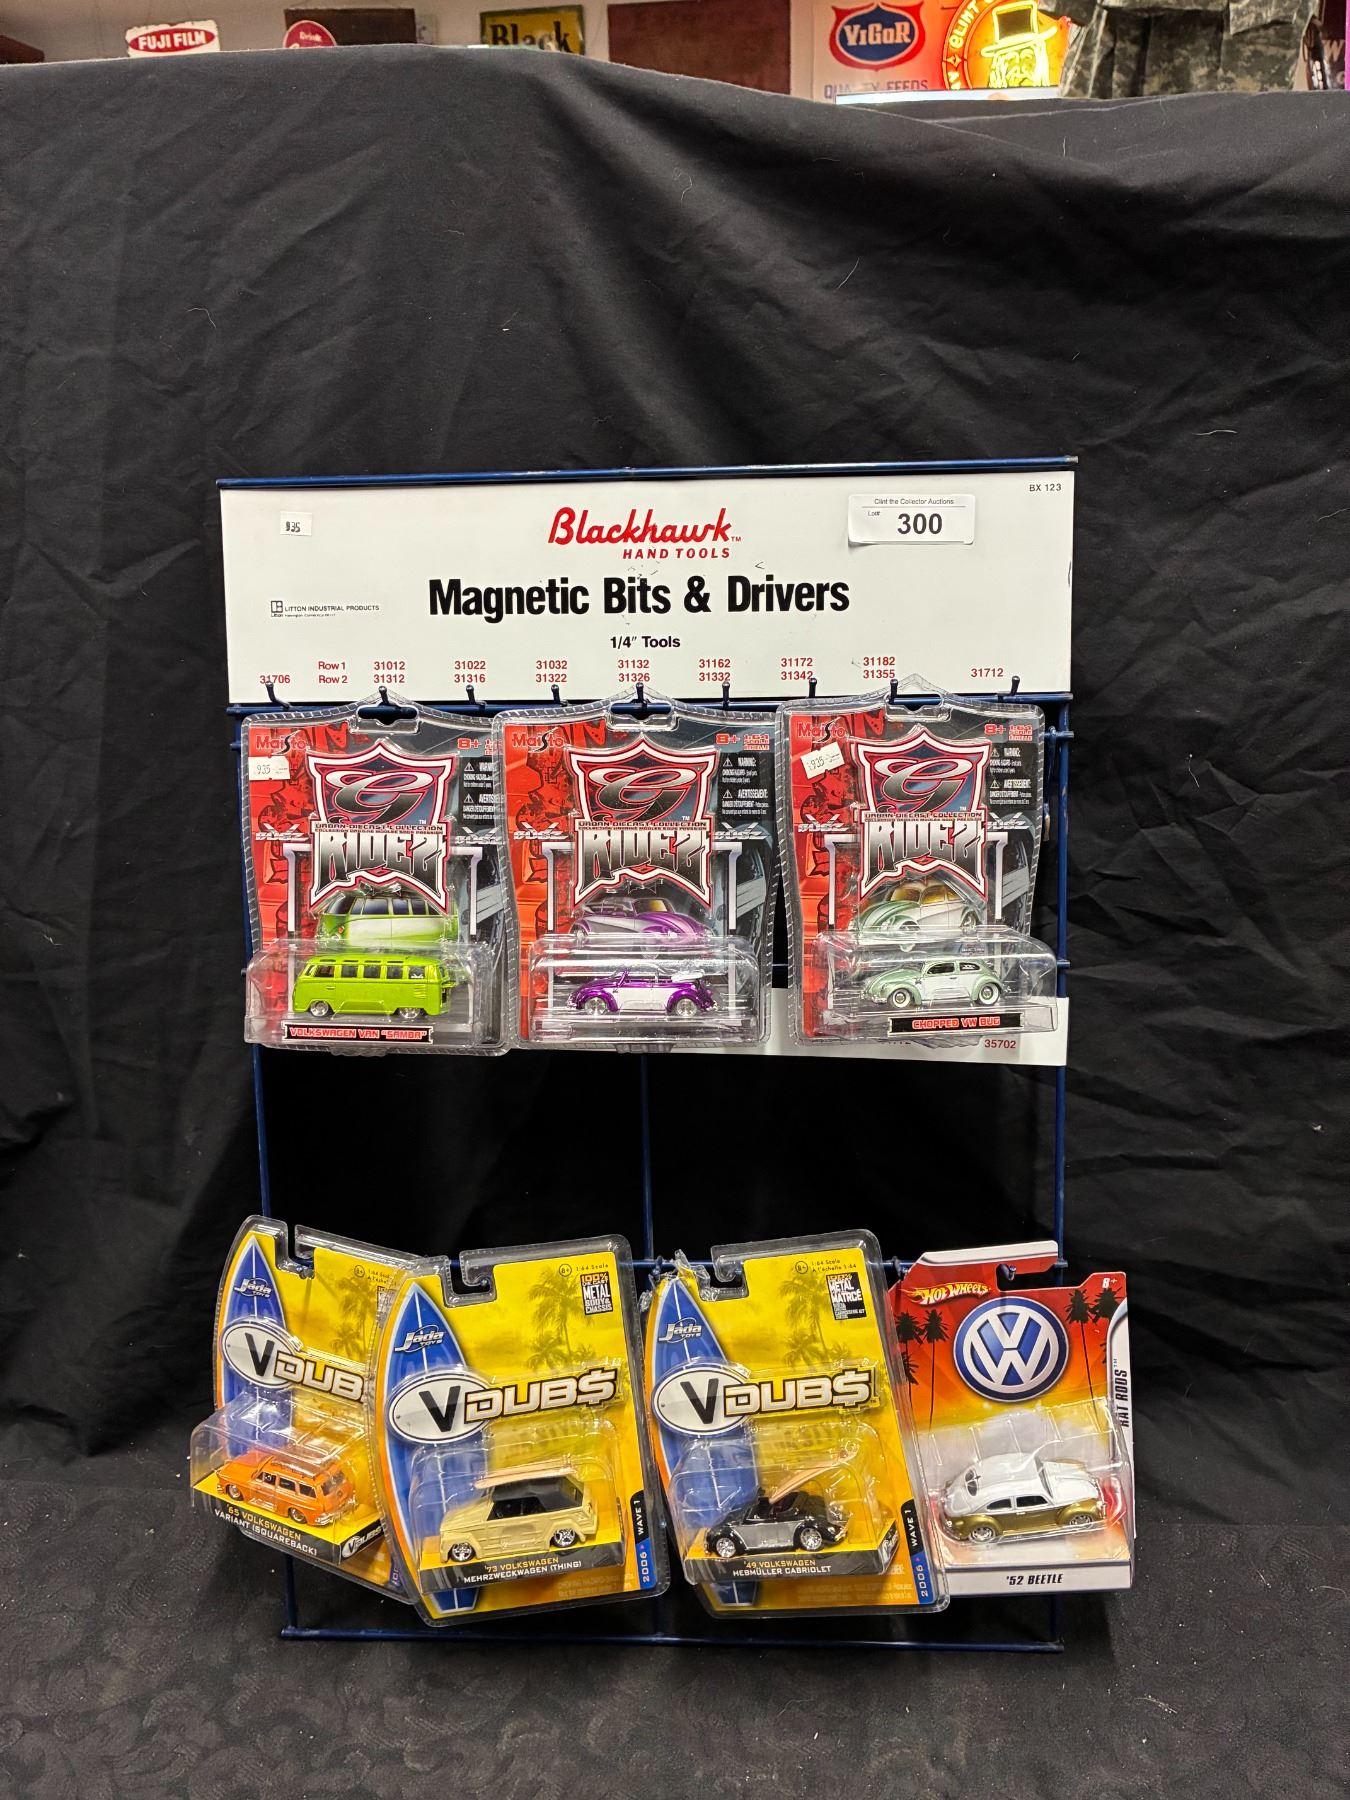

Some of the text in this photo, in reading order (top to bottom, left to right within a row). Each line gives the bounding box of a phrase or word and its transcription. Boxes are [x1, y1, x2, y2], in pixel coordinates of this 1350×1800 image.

[138, 31, 206, 50] FUJI FILM
[1029, 483, 1062, 492] BX 123
[548, 507, 732, 545] Blackhawk
[897, 512, 943, 535] 300
[623, 547, 730, 560] HAND TOOLS
[429, 574, 850, 624] Magnetic Bits & Drivers
[641, 635, 681, 648] Tools
[318, 656, 896, 671] Row 1 31012 31022 31032 31132 31162 31172 31182
[259, 674, 291, 684] 31706
[318, 669, 896, 684] Row 2 31312 31316 31322 31326 31332 31342 31355
[970, 667, 1004, 678] 31712
[797, 719, 847, 741] Maisto
[984, 723, 1006, 734] 8+
[255, 731, 309, 753] Maisto
[457, 738, 481, 749] 8+
[512, 728, 565, 751] Maisto
[716, 733, 740, 745] 8+
[912, 1016, 1000, 1029] CHOPPED VW BUG
[290, 1027, 356, 1038] VOLKSWAGEN
[358, 1028, 379, 1039] VAN
[984, 1039, 1017, 1050] 35702
[234, 1278, 272, 1294] Jada
[581, 1273, 609, 1283] 100%
[1102, 1277, 1118, 1288] 8+
[583, 1284, 611, 1300] METAL
[923, 1286, 950, 1305] HOT
[585, 1298, 605, 1307] BODY
[585, 1304, 613, 1314] CHASSIS
[395, 1331, 445, 1351] Jada
[658, 1323, 702, 1343] Jada
[244, 1332, 366, 1403] V DUB
[1114, 1369, 1129, 1402] RODS
[418, 1385, 461, 1433] V
[680, 1378, 719, 1425] V
[227, 1504, 302, 1541] '65 VOLKSWAGEN
[635, 1507, 644, 1535] WAVE
[214, 1509, 317, 1556] VARIANT (SQUAREBACK)
[907, 1517, 918, 1547] WAVE
[464, 1560, 582, 1583] MEHRZWECKWAGEN (THING)
[485, 1557, 559, 1573] '73 VOLKSWAGEN
[640, 1551, 650, 1583] 2006
[732, 1565, 832, 1577] HEBMÜLLER CABRIOLET
[743, 1559, 816, 1569] '49 VOLKSWAGEN
[916, 1564, 929, 1597] 2006
[1006, 1573, 1063, 1586] '52 BEETLE
